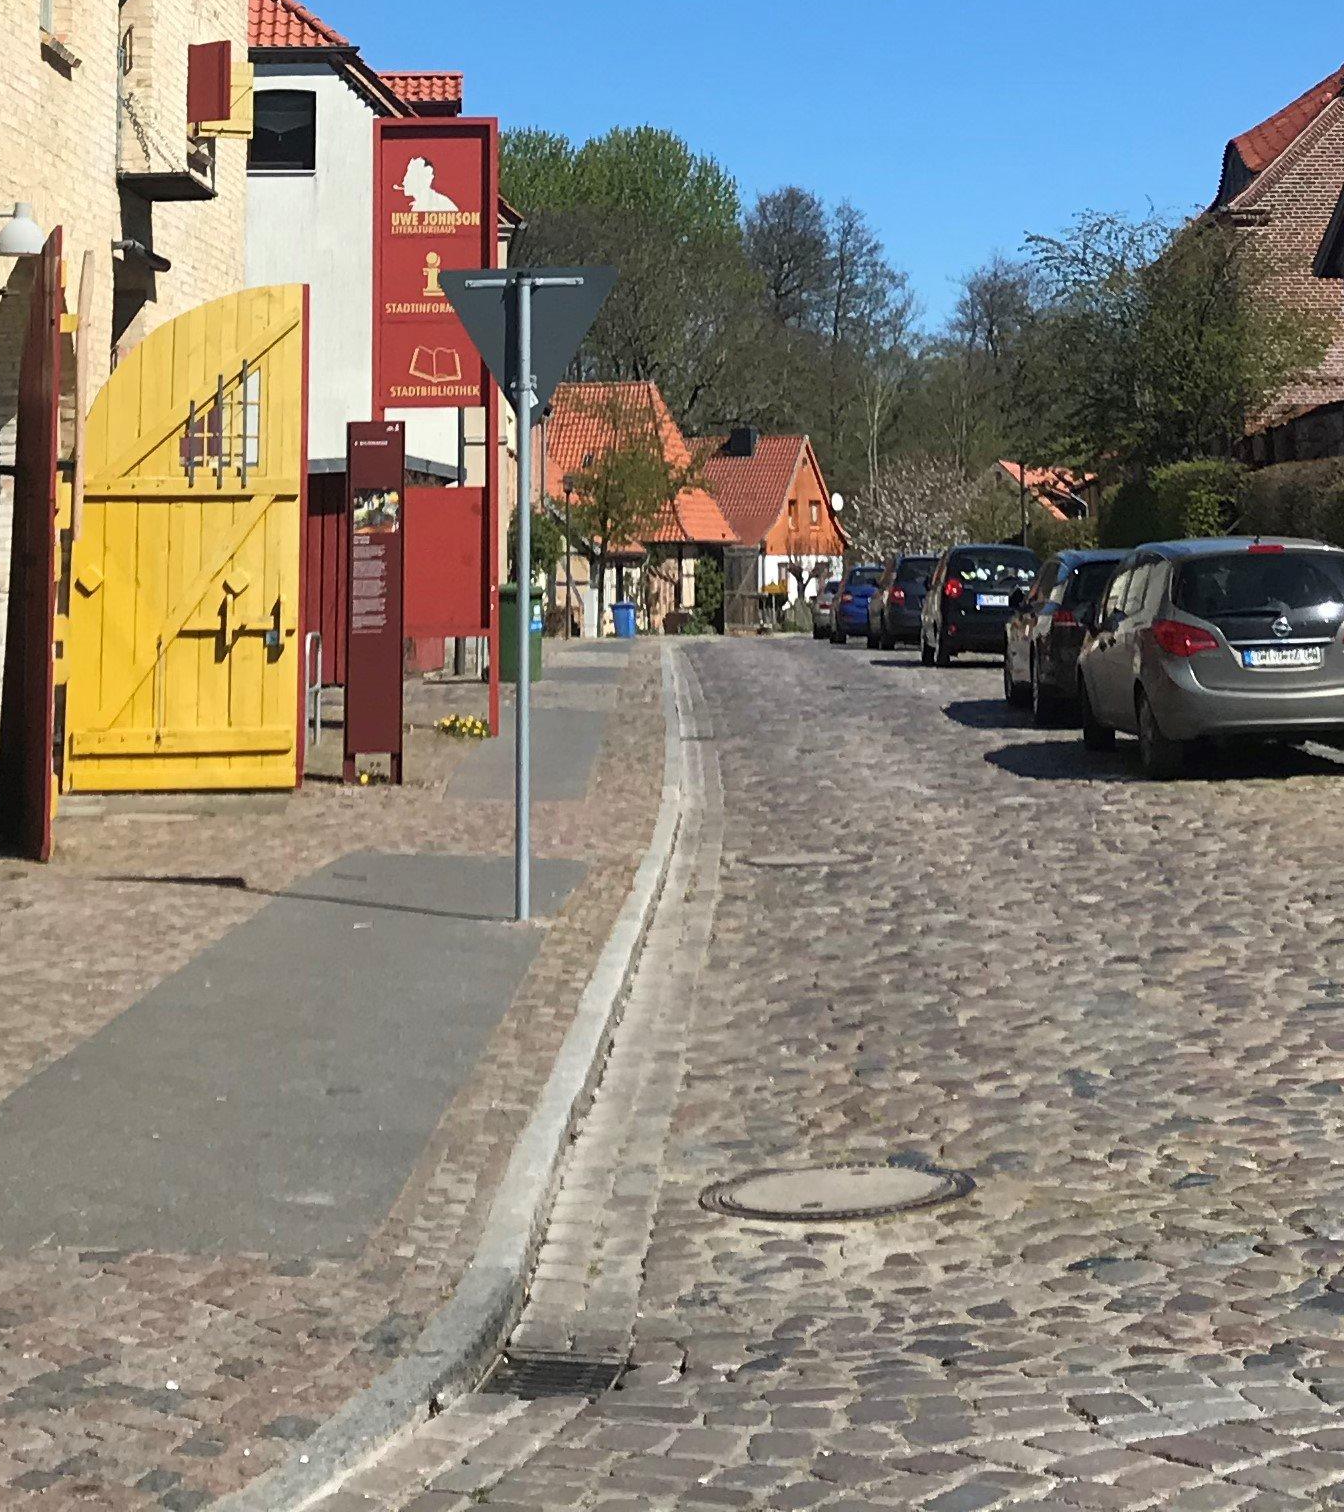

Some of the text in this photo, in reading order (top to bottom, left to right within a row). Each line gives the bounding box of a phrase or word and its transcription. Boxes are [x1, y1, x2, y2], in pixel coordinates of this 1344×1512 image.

[391, 212, 480, 226] UWE JOHNSON
[391, 226, 456, 235] LITERATURHAUS
[389, 385, 481, 398] STADTBIBLIOTHEK
